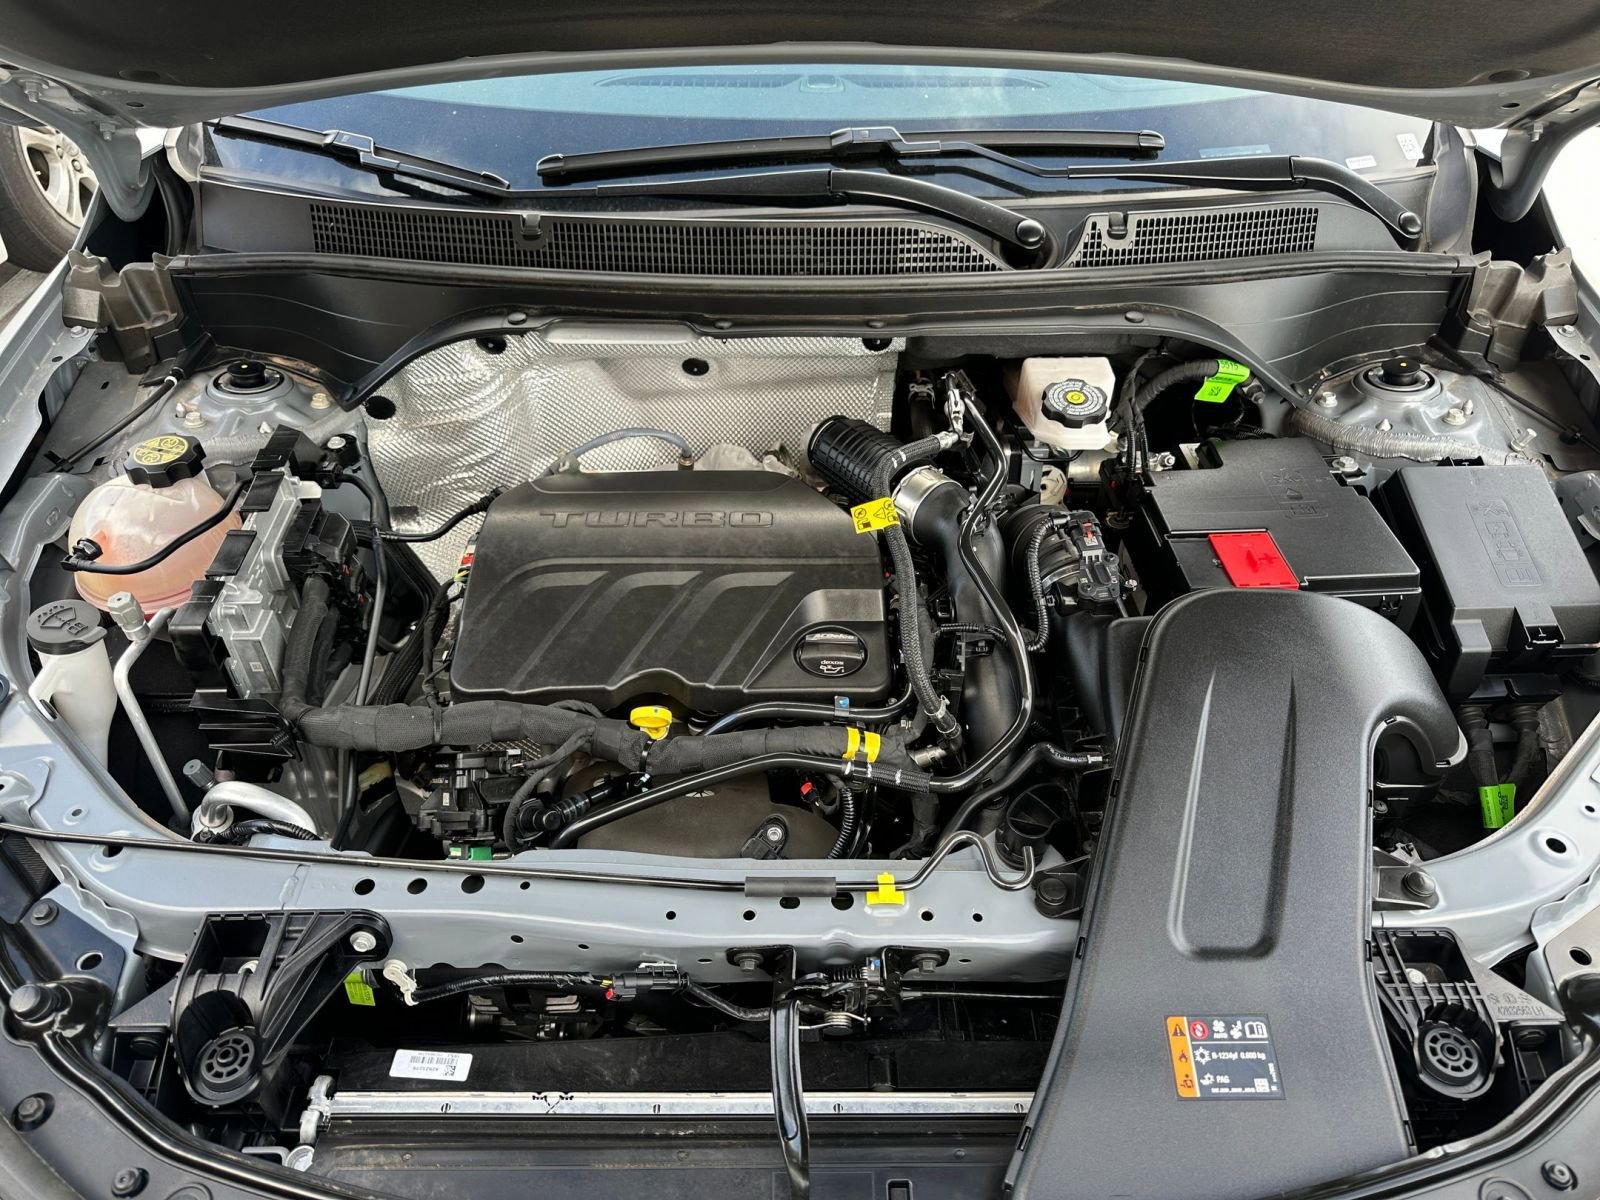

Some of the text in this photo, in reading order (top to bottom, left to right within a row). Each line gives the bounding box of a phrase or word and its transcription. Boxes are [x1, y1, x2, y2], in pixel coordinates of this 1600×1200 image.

[540, 511, 773, 528] TURBO
[1257, 1052, 1266, 1060] kg
[1216, 1075, 1230, 1083] PAG
